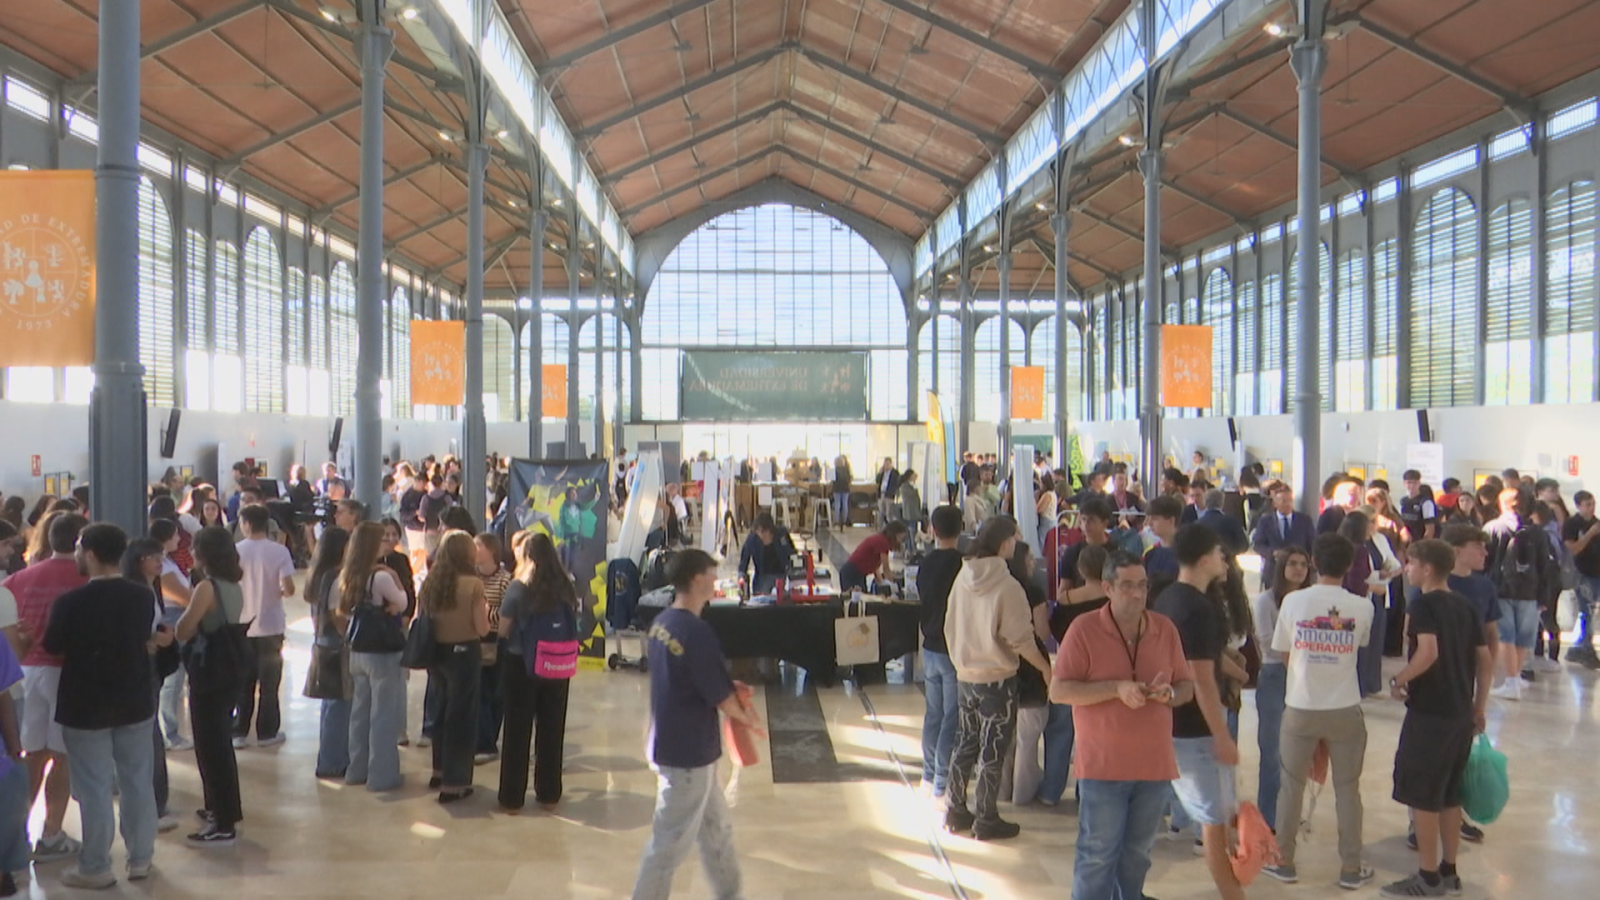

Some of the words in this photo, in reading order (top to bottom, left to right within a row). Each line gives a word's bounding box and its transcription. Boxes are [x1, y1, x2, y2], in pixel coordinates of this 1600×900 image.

[21, 214, 40, 224] DE
[48, 216, 91, 318] EXTREMADURA
[1294, 640, 1355, 654] OPERATOR
